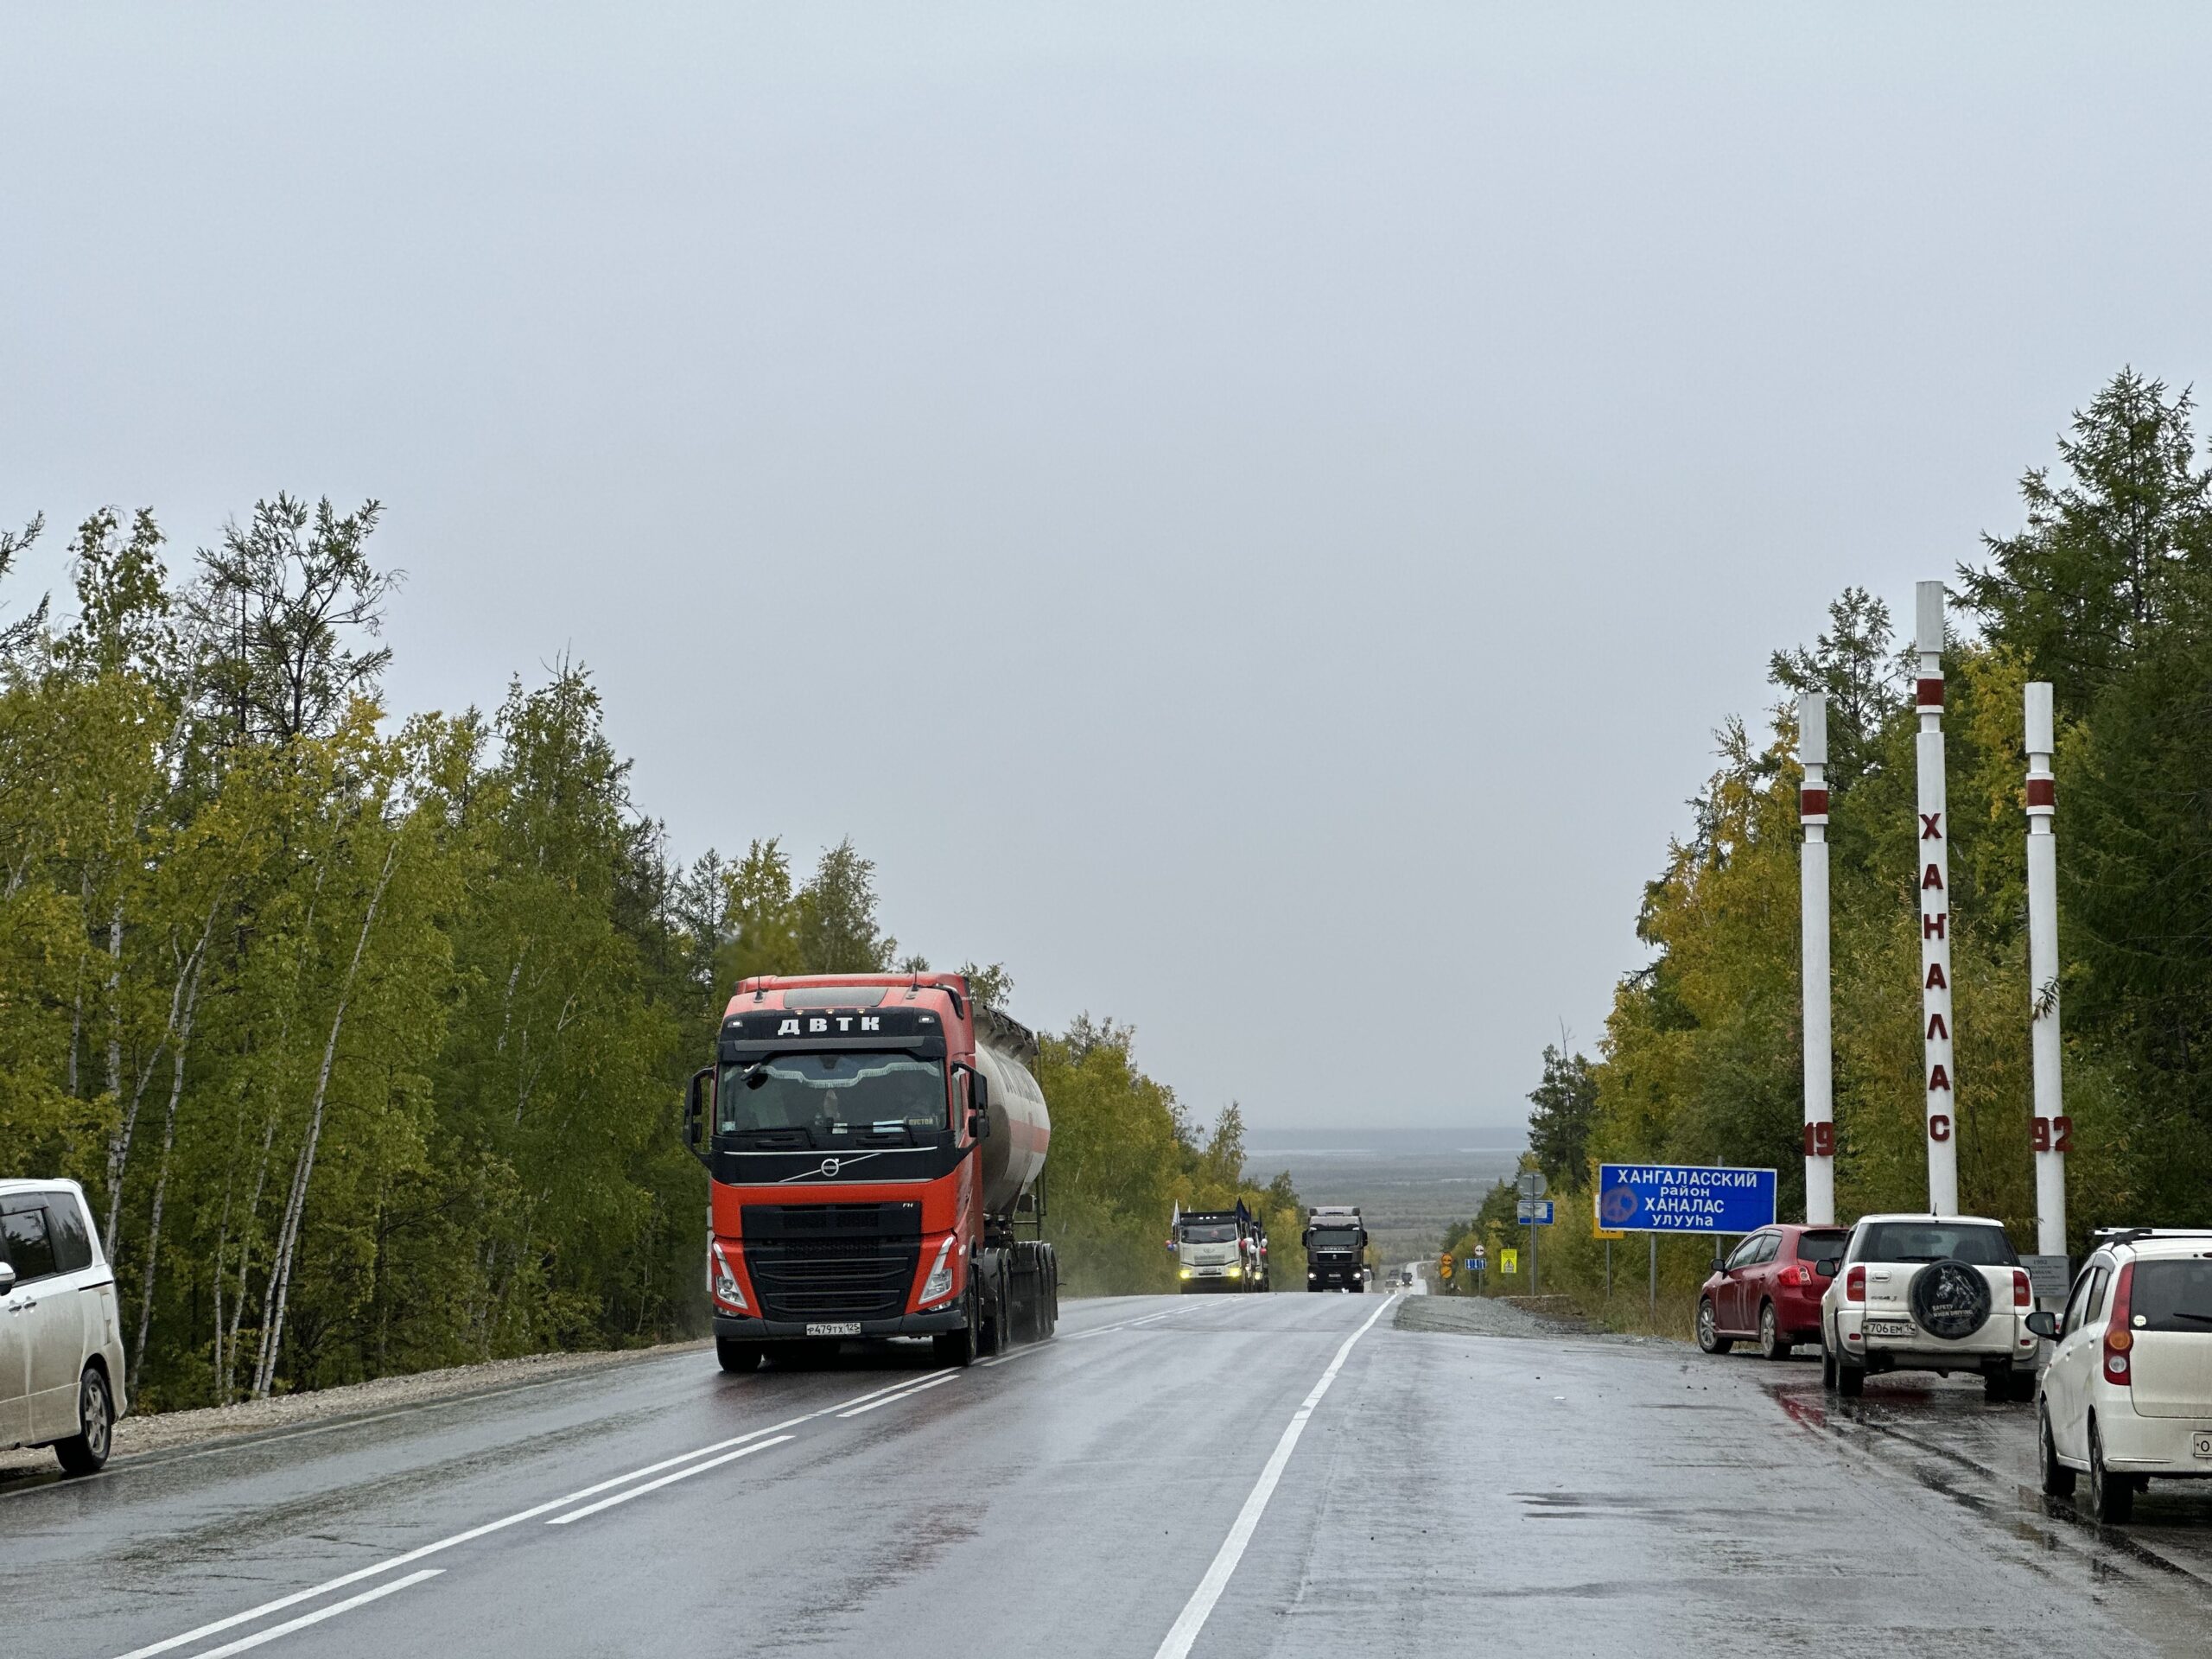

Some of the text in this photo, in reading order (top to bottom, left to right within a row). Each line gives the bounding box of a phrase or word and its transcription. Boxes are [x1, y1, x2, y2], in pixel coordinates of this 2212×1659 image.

[777, 1016, 880, 1036] ДВТК
[1803, 1122, 1835, 1156] 19
[2031, 1116, 2074, 1153] 92
[1618, 1170, 1757, 1187] ХАНГАЛАССКИЙ
[1660, 1185, 1710, 1197] район
